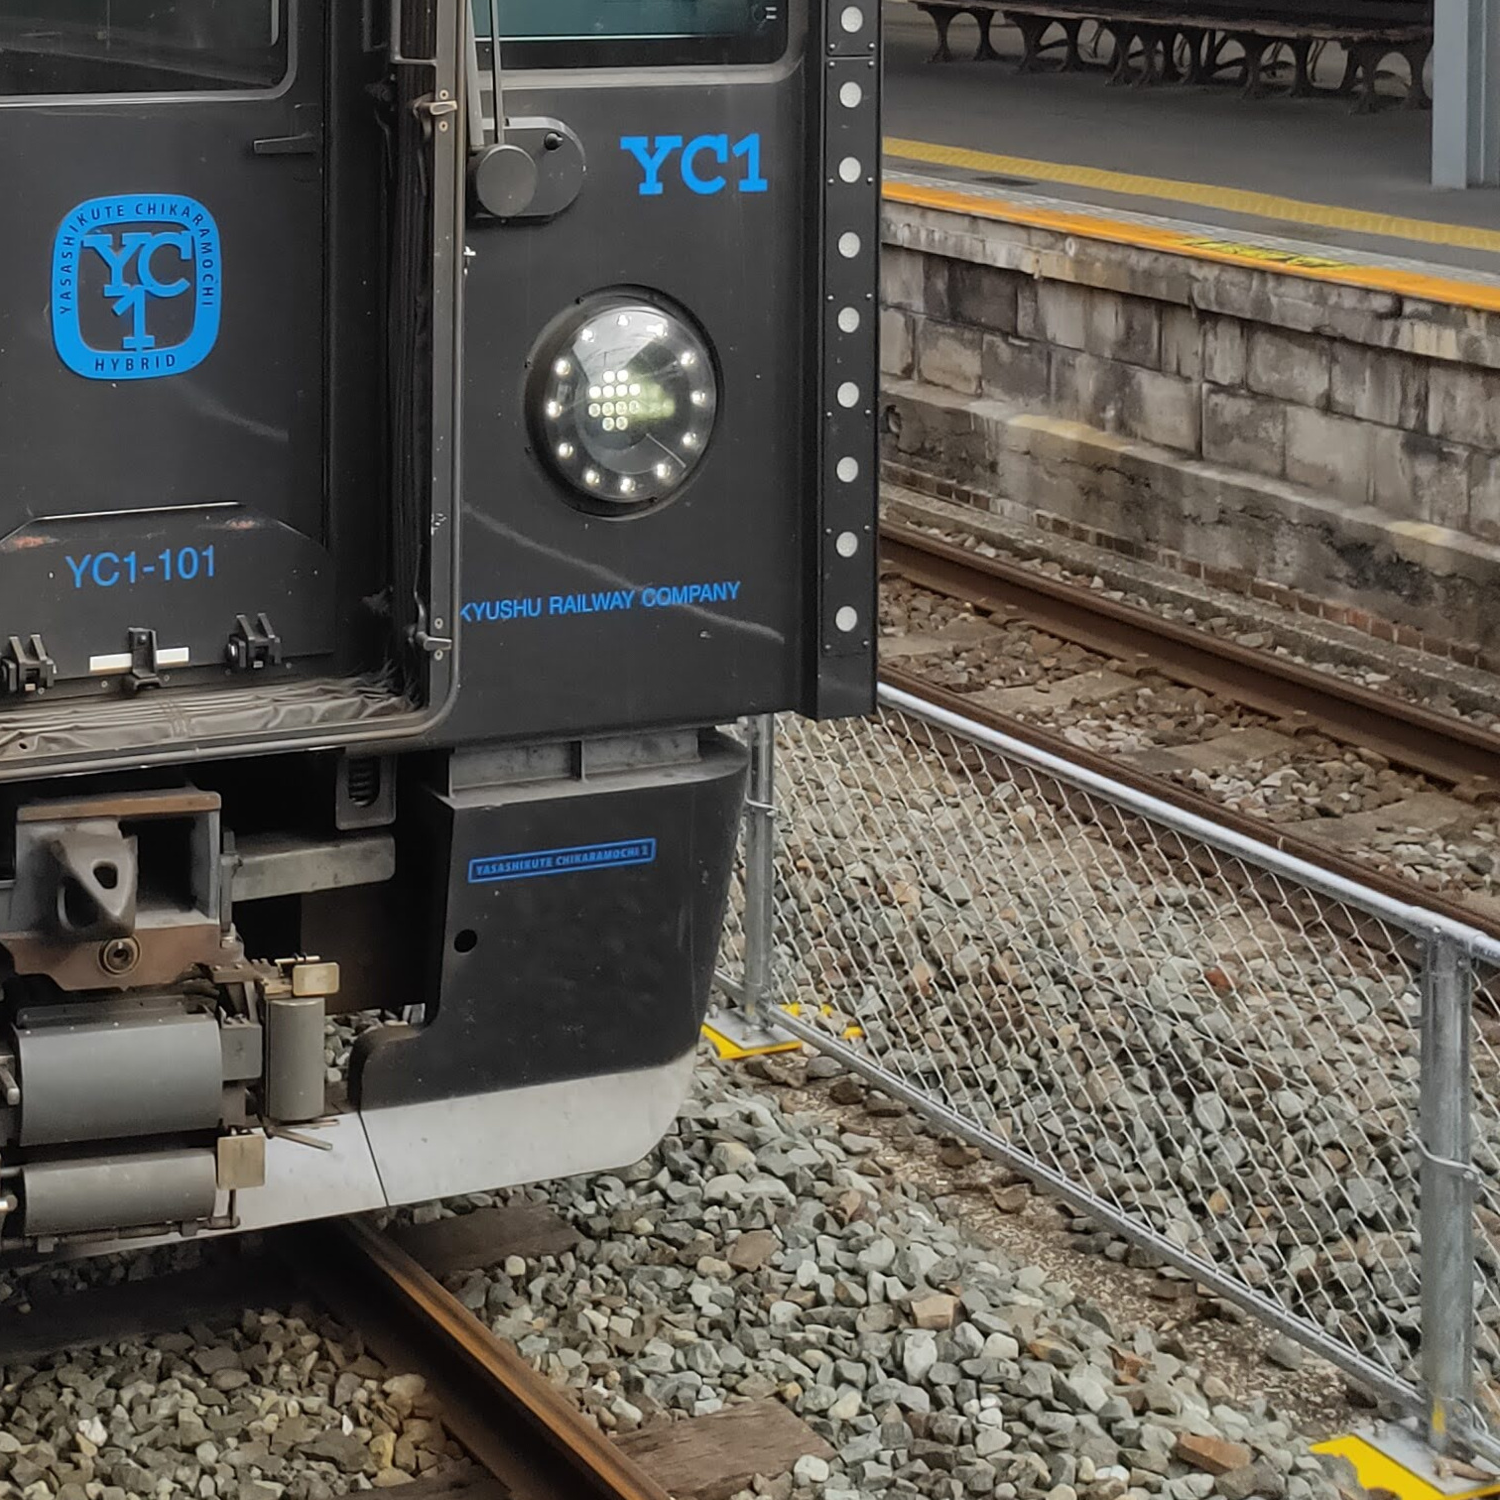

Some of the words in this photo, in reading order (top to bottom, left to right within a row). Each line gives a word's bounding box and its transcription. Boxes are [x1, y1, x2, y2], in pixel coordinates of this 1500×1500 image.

[619, 132, 768, 196] YC1
[59, 204, 125, 315] YASASHIKUTE
[135, 202, 213, 307] CHIKARAMOCHI
[94, 353, 176, 372] HYBRID
[64, 543, 215, 588] YC1-101
[460, 597, 542, 622] KYUSHU
[549, 589, 636, 615] RAILWAY
[641, 581, 741, 608] COMPANY
[475, 857, 553, 877] YASASHIKUTE
[555, 847, 639, 866] CHIKARAMOCHI
